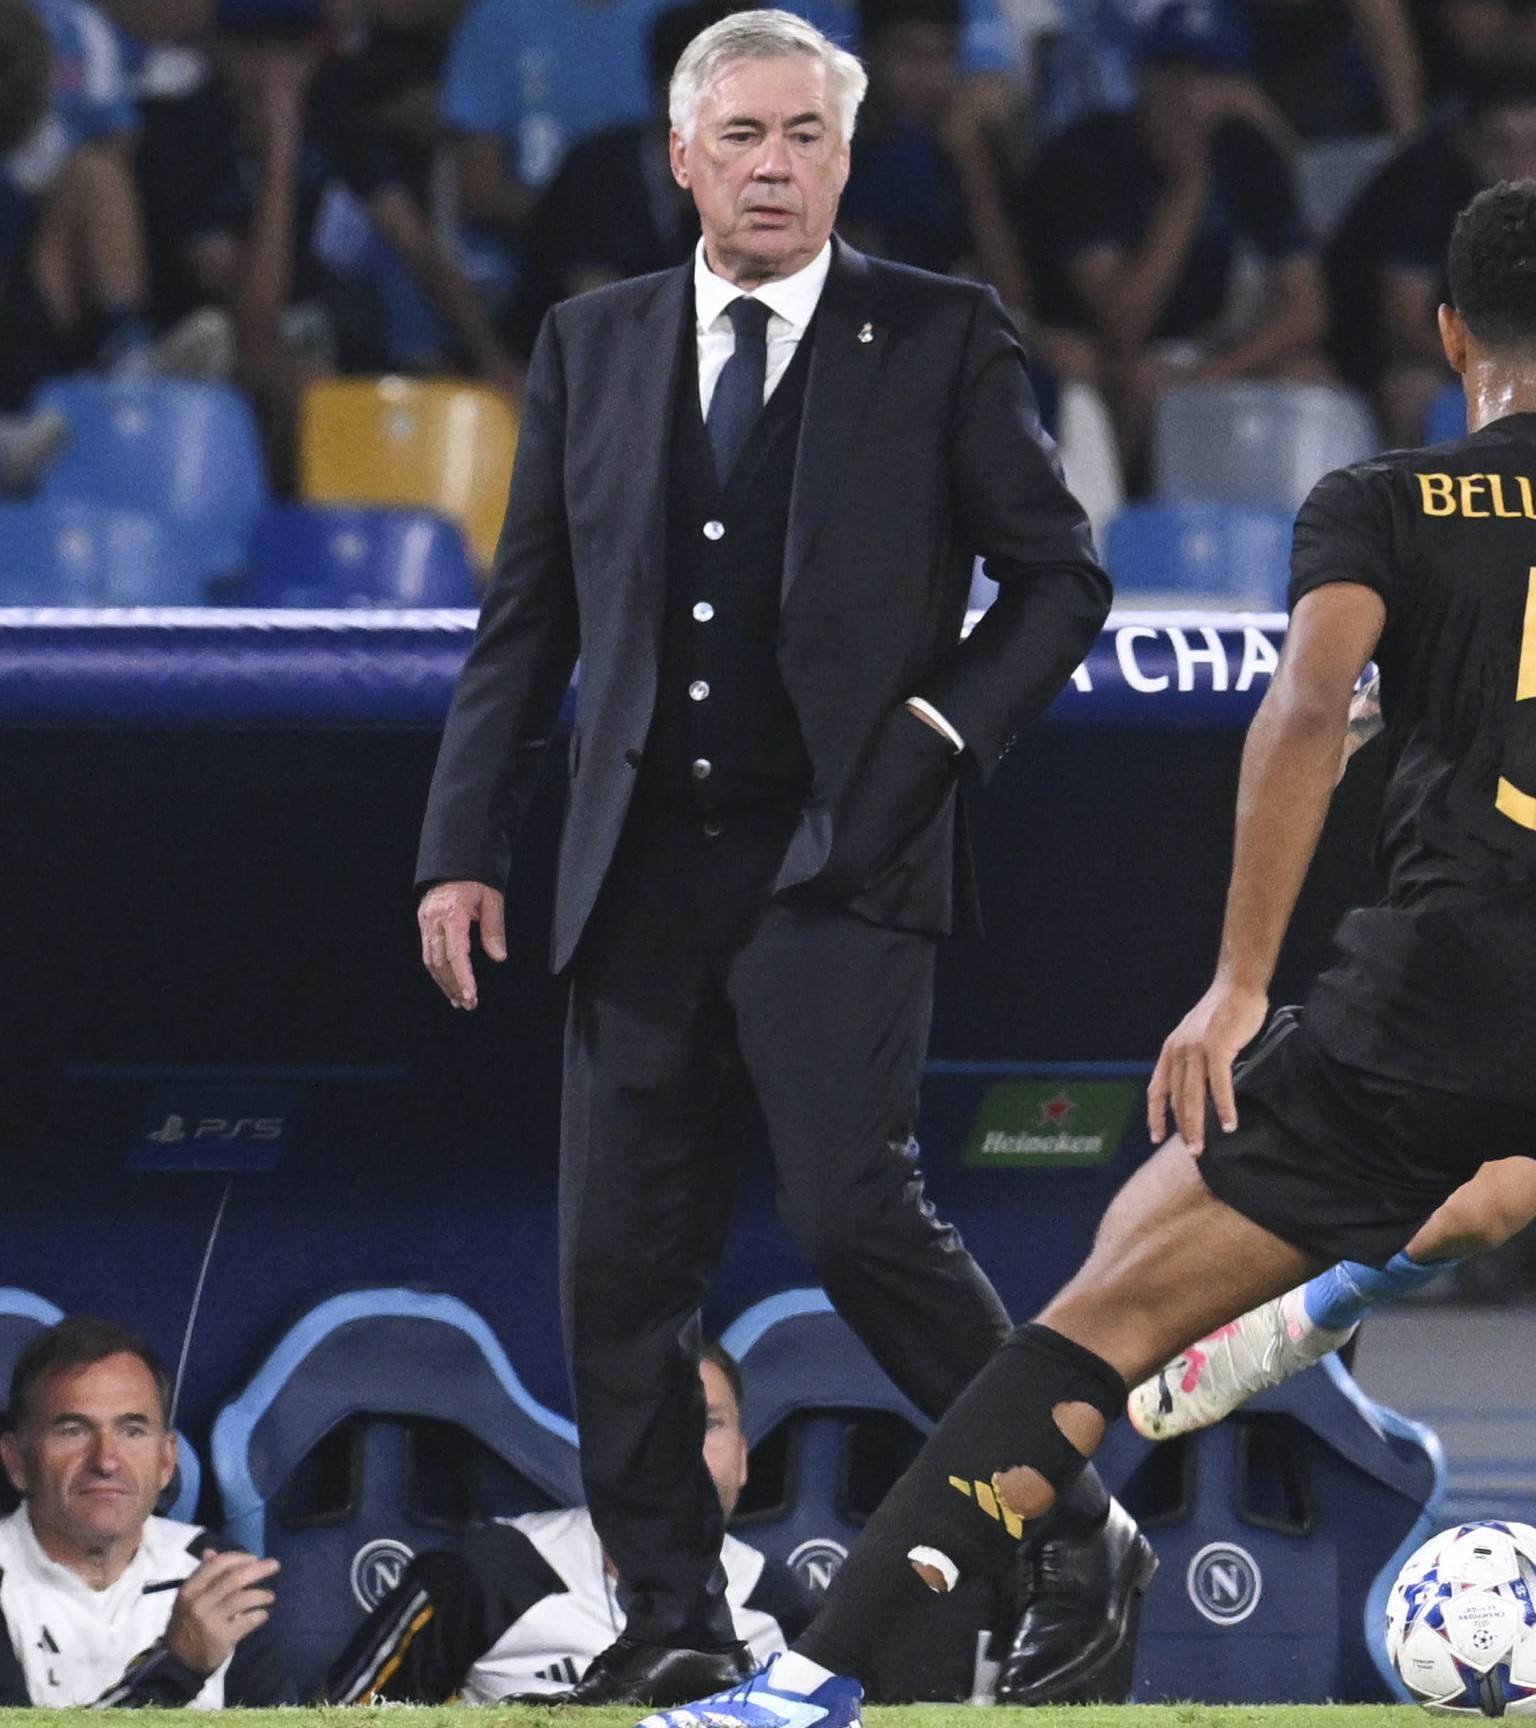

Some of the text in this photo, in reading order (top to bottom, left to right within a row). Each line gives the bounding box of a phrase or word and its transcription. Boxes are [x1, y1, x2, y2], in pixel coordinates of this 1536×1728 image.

[193, 1117, 286, 1140] PS5
[981, 1130, 1104, 1153] Heineken
[1209, 1564, 1239, 1601] N
